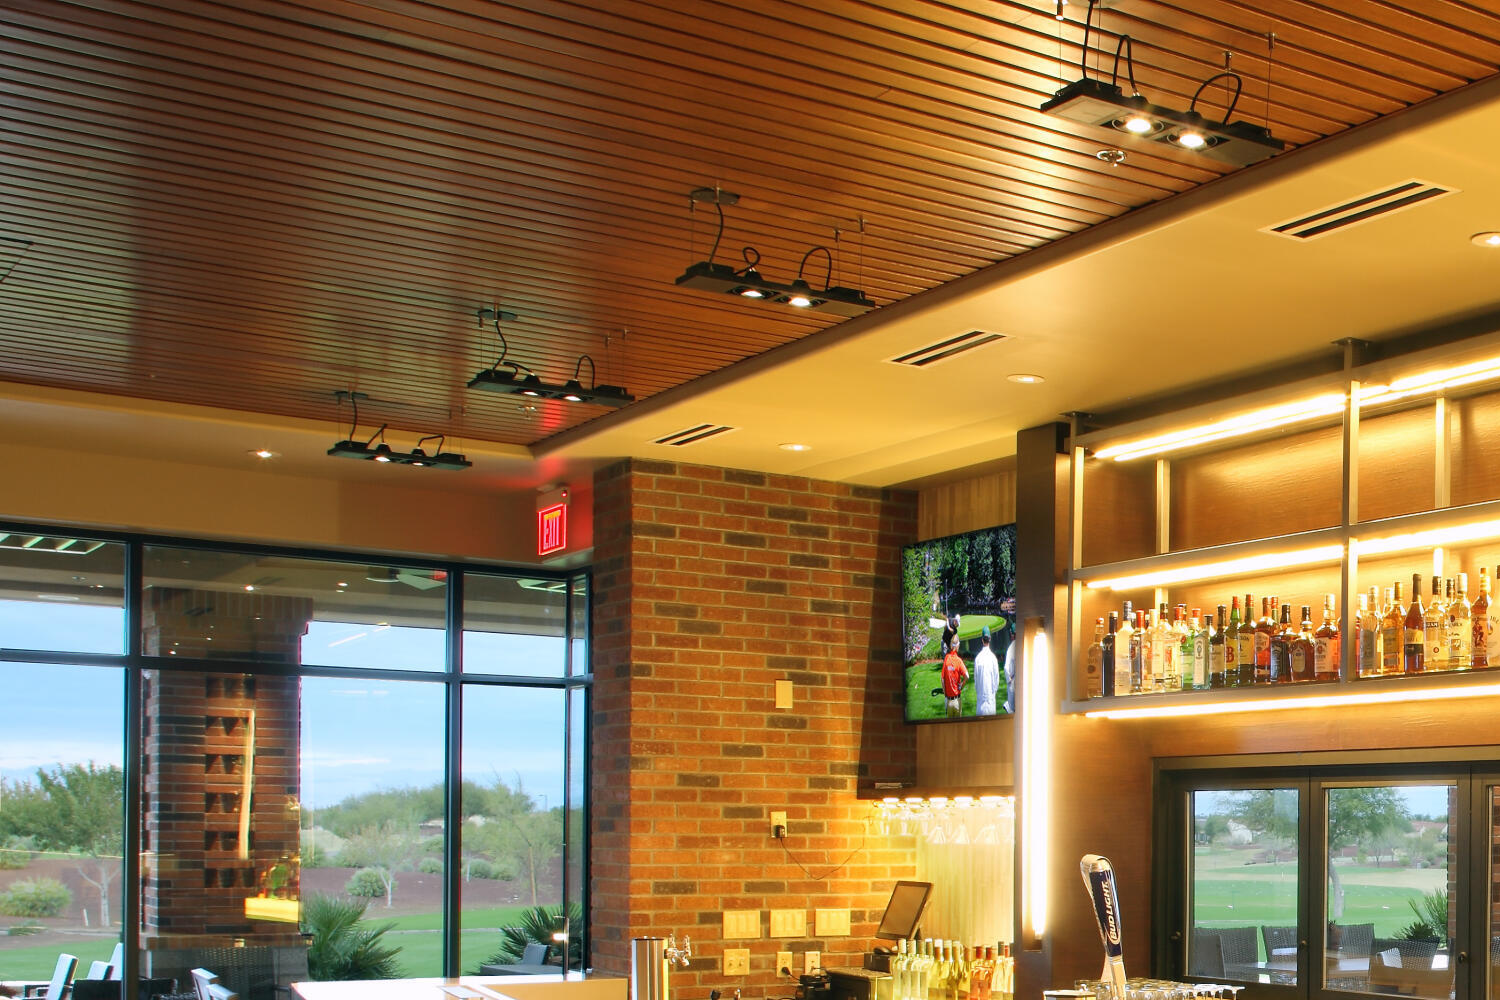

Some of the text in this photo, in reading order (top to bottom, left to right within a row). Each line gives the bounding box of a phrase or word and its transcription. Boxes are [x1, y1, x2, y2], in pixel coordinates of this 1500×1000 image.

[543, 510, 561, 549] EXIT
[1102, 880, 1117, 940] BUD LIGHT
